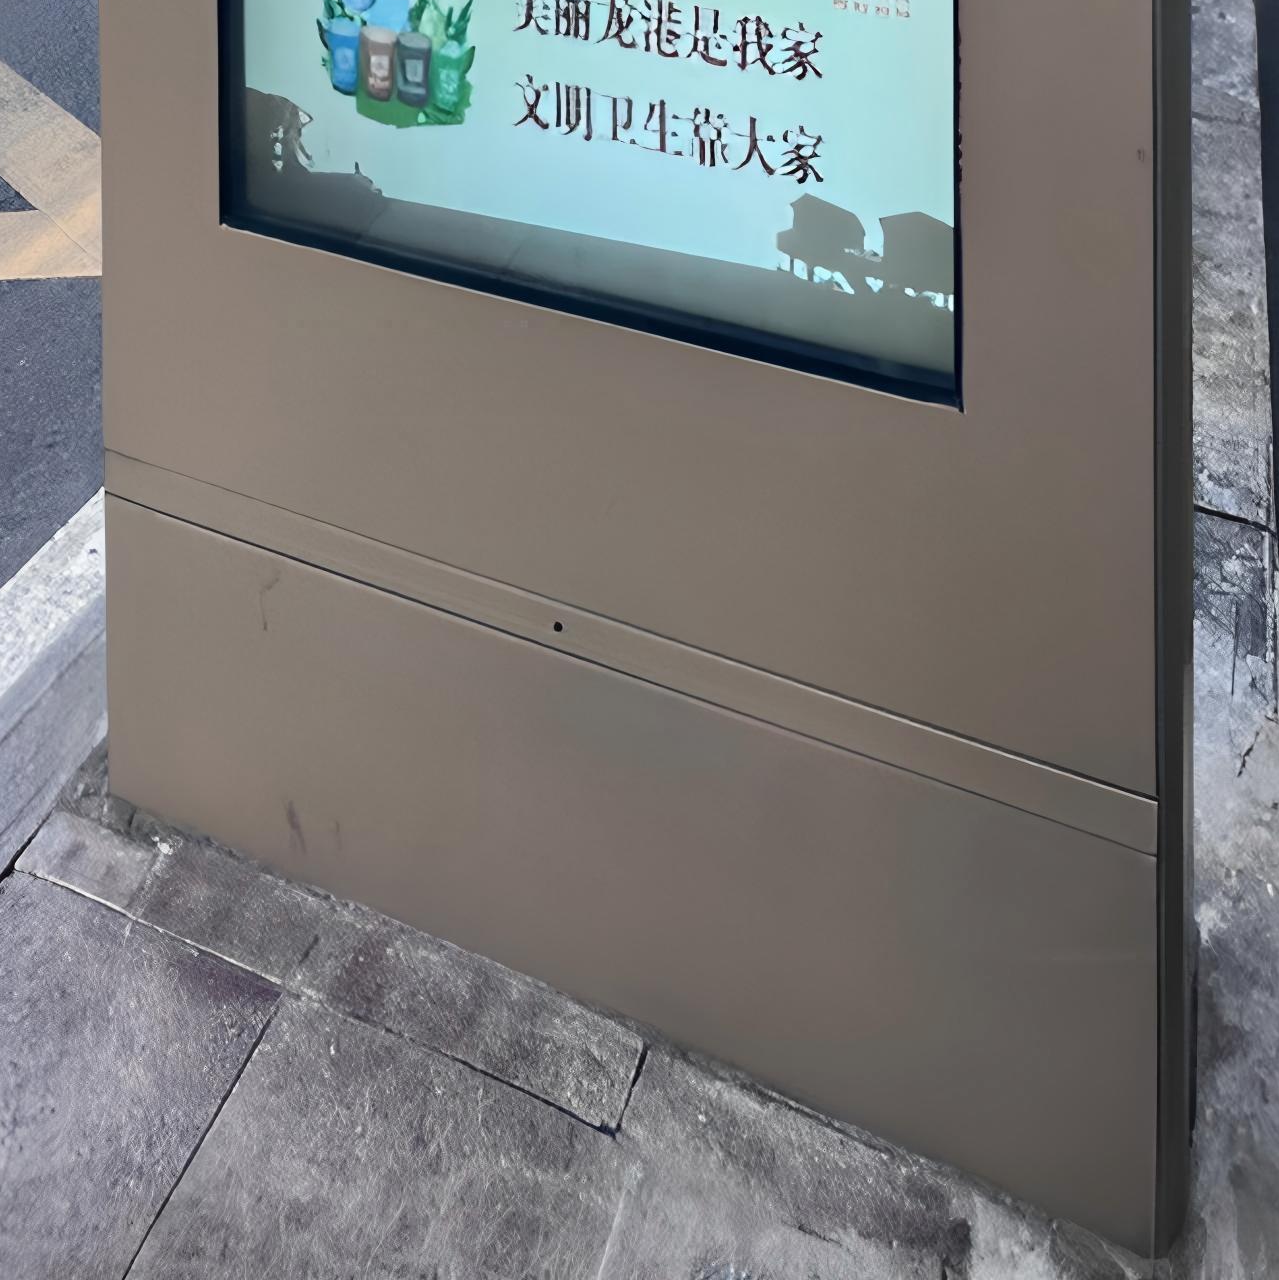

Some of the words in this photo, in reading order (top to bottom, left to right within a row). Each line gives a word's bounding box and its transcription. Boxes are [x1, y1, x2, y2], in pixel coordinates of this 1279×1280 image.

[513, 74, 824, 184] 文明卫生靠大家
